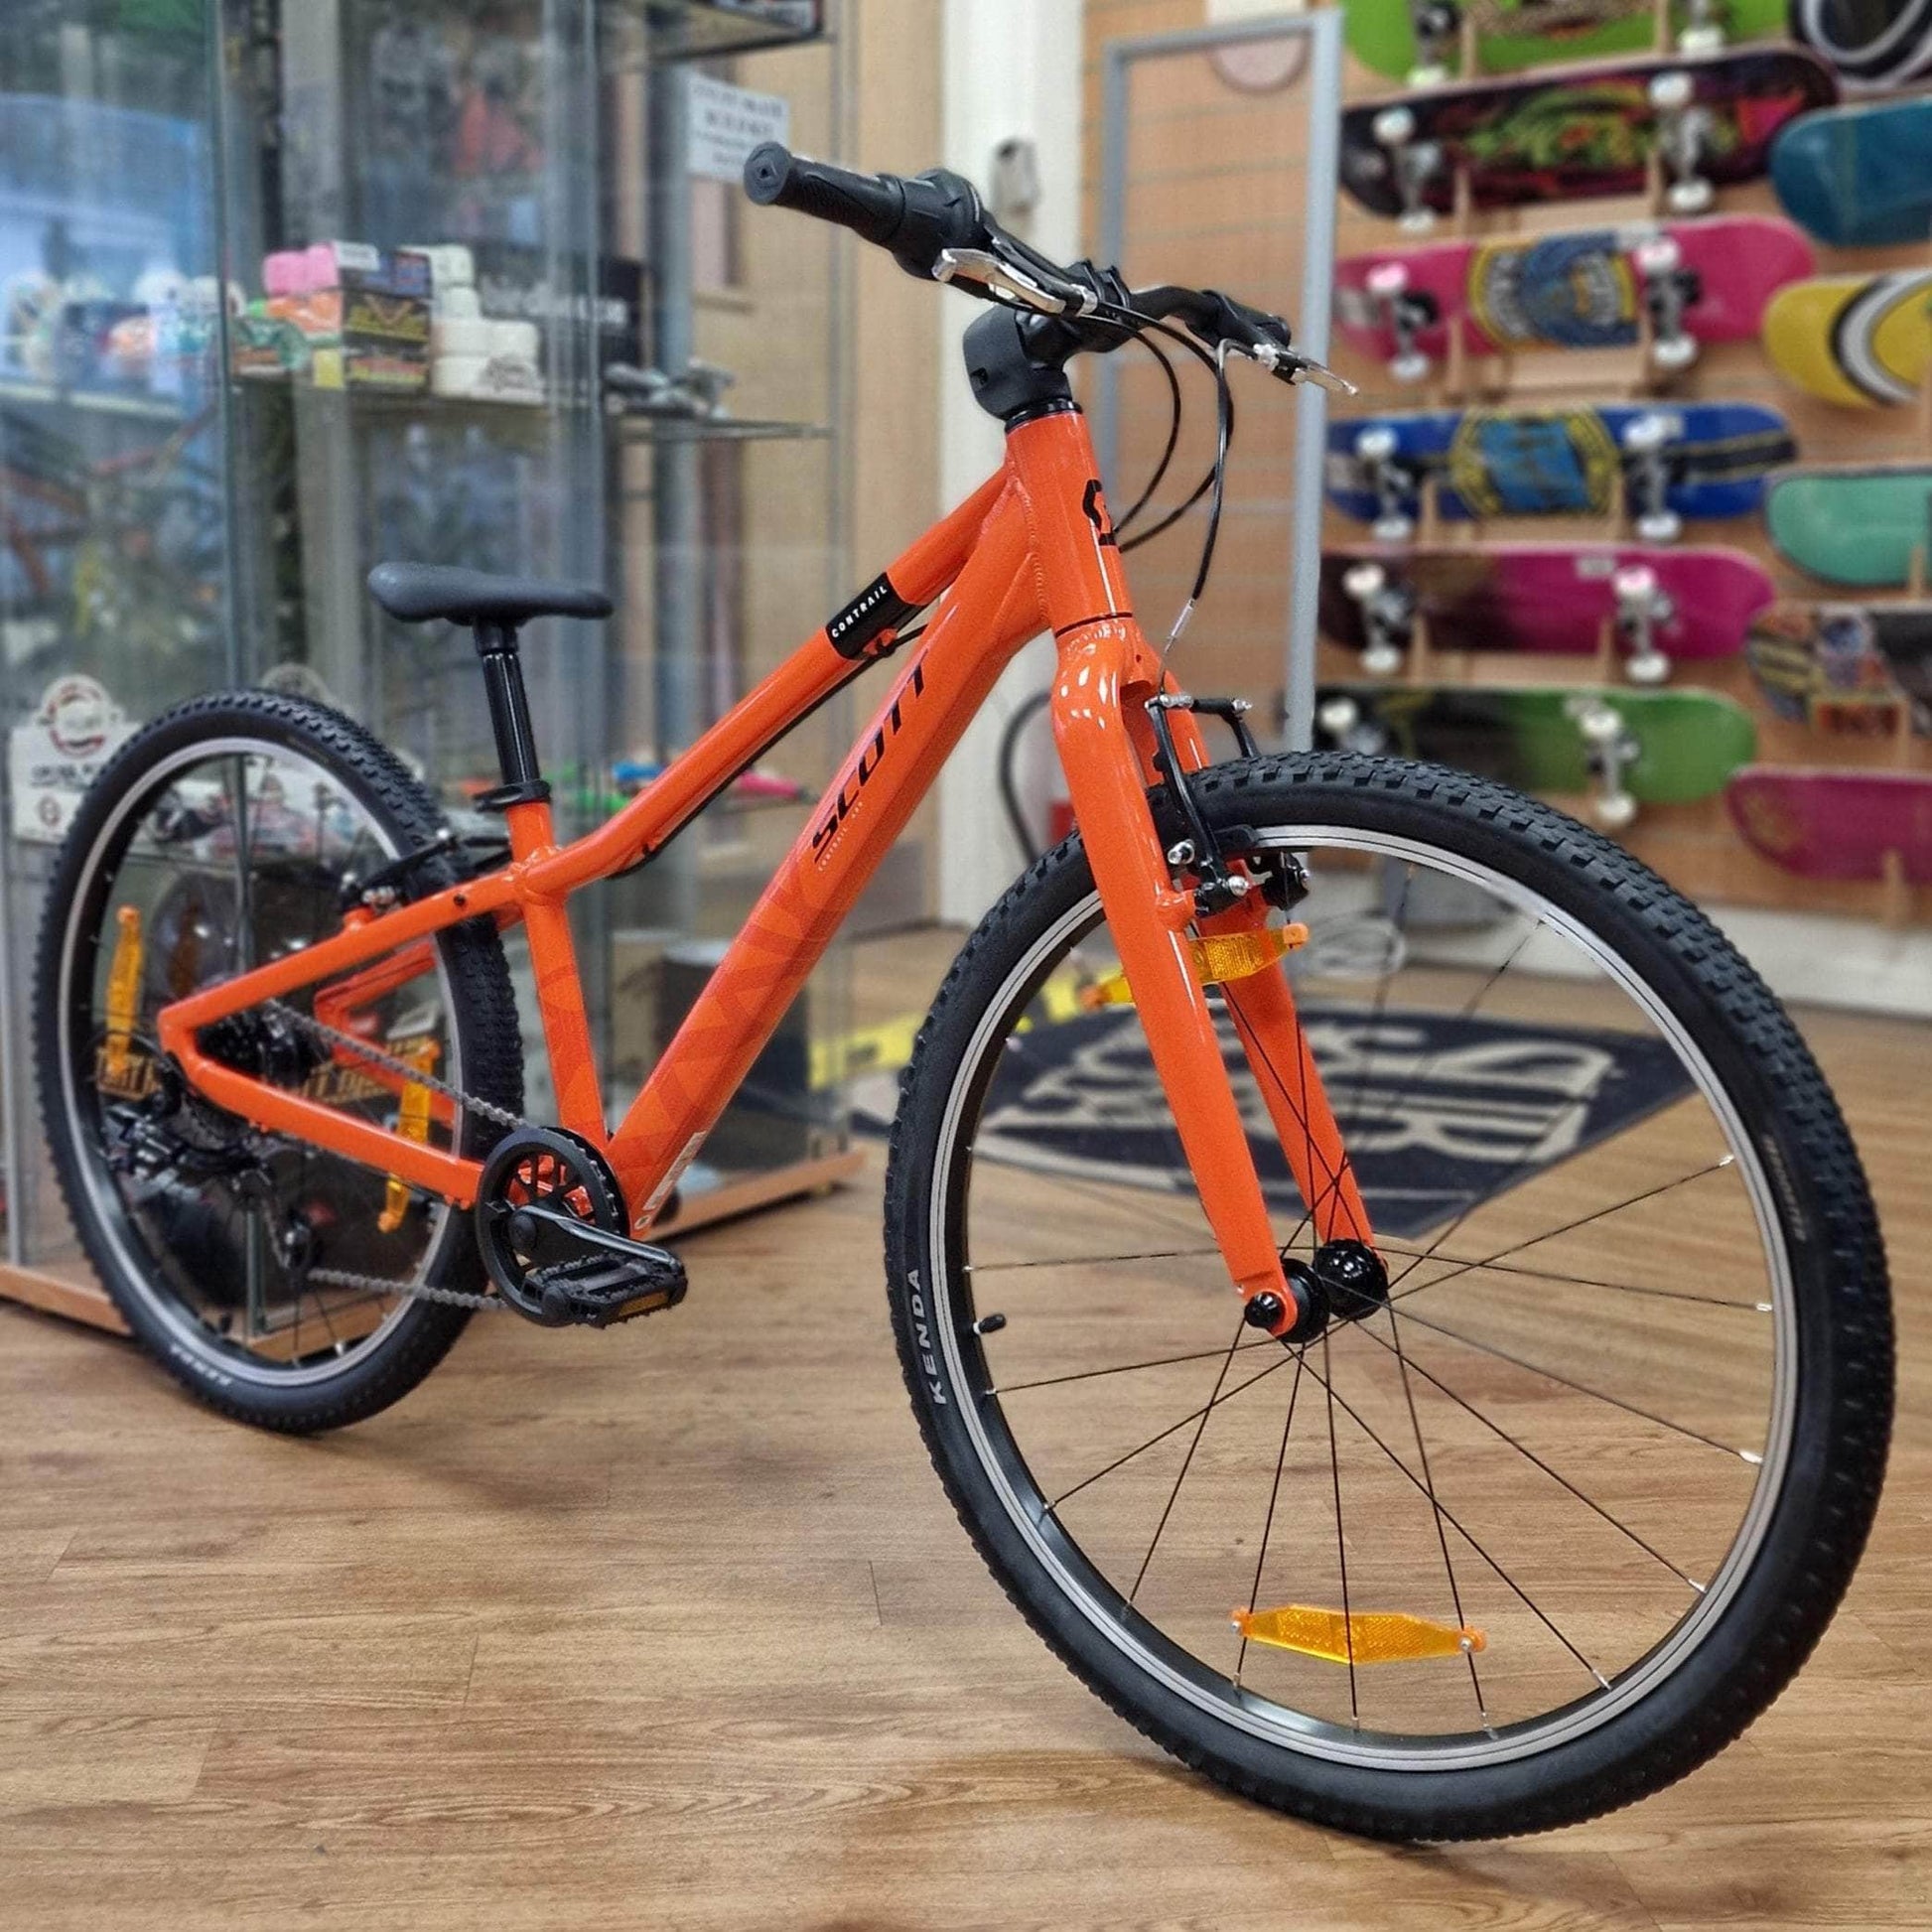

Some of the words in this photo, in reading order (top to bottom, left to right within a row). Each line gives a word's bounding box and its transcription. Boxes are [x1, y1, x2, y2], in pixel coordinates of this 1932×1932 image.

[831, 586, 887, 637] CONTRAIL
[812, 648, 928, 863] SCOTT
[907, 1269, 947, 1405] KENDA
